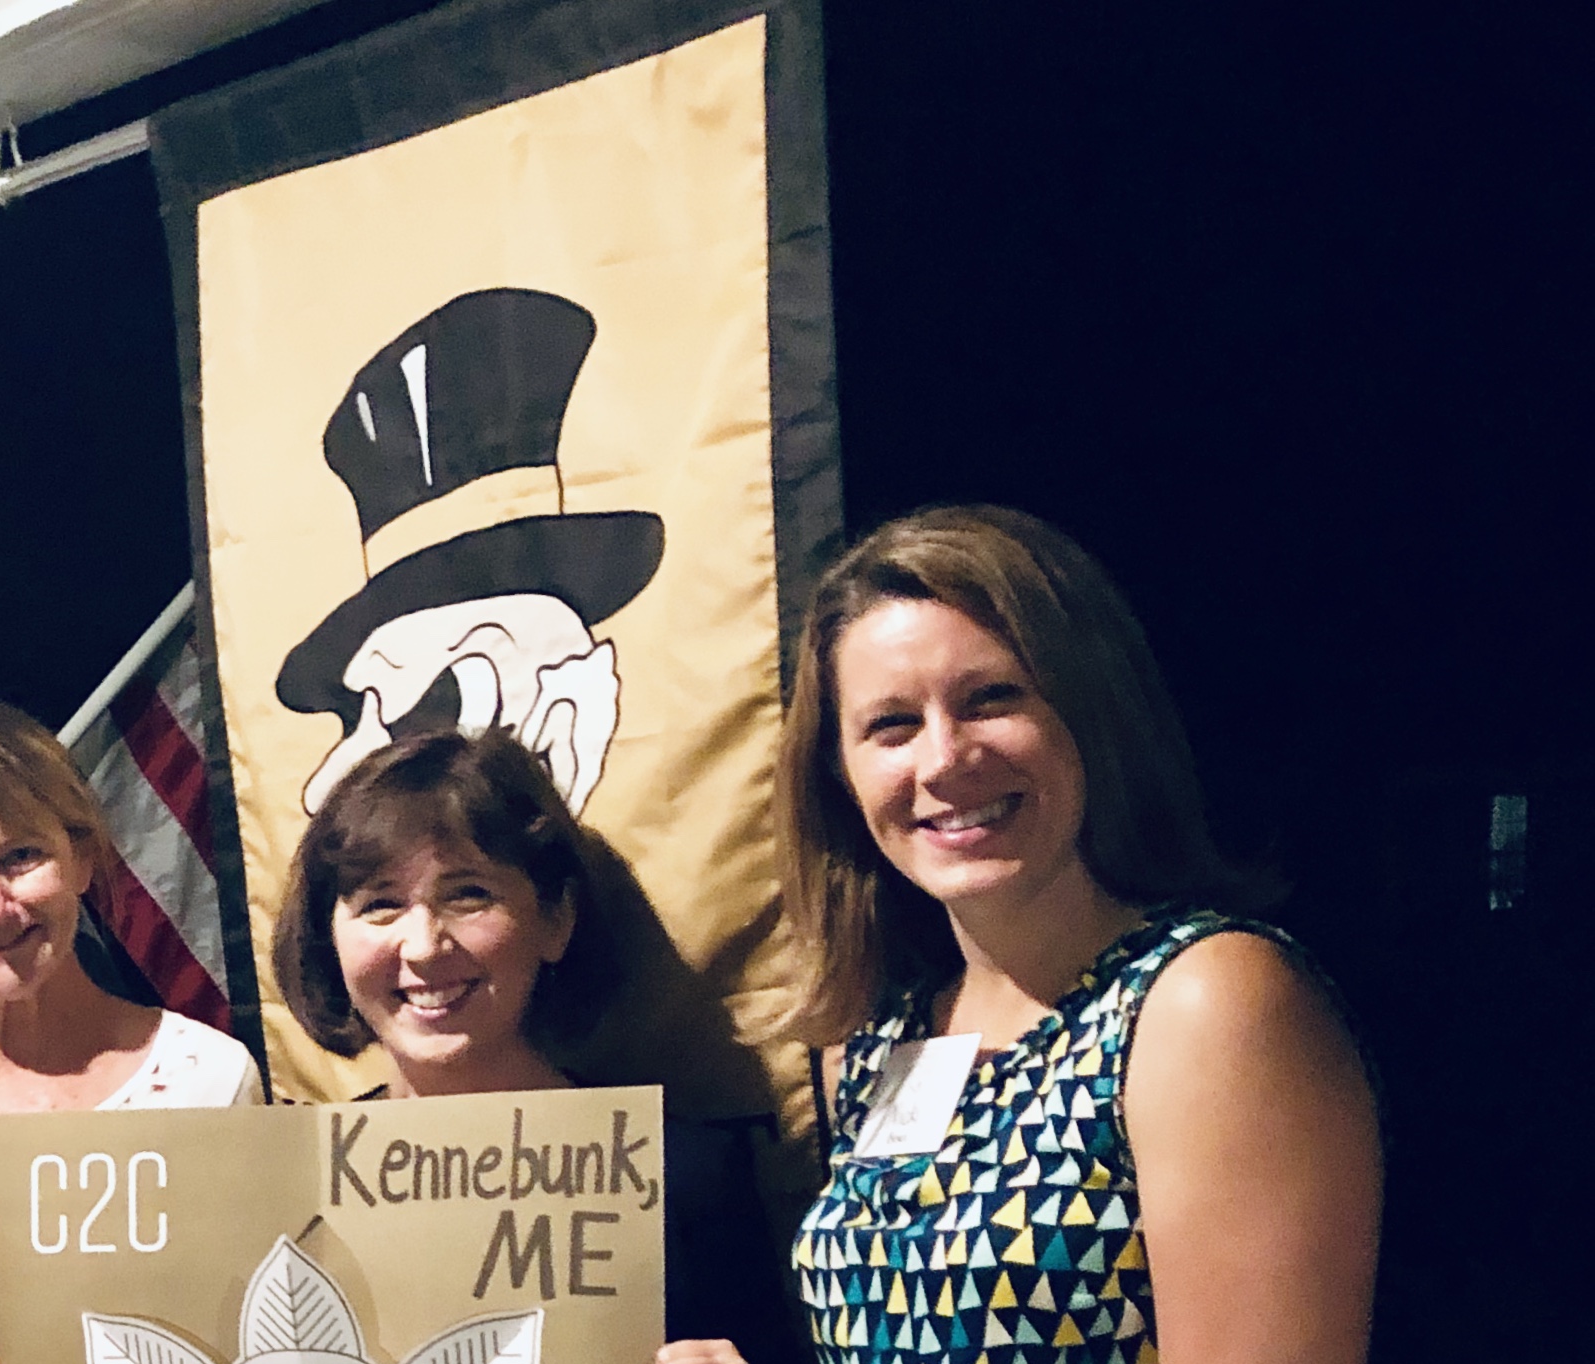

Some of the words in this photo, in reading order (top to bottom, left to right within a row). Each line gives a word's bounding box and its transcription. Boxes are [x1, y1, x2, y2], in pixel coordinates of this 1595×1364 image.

[29, 1150, 168, 1254] C2C
[330, 1107, 659, 1211] Kennebunk,
[473, 1209, 621, 1300] ME
